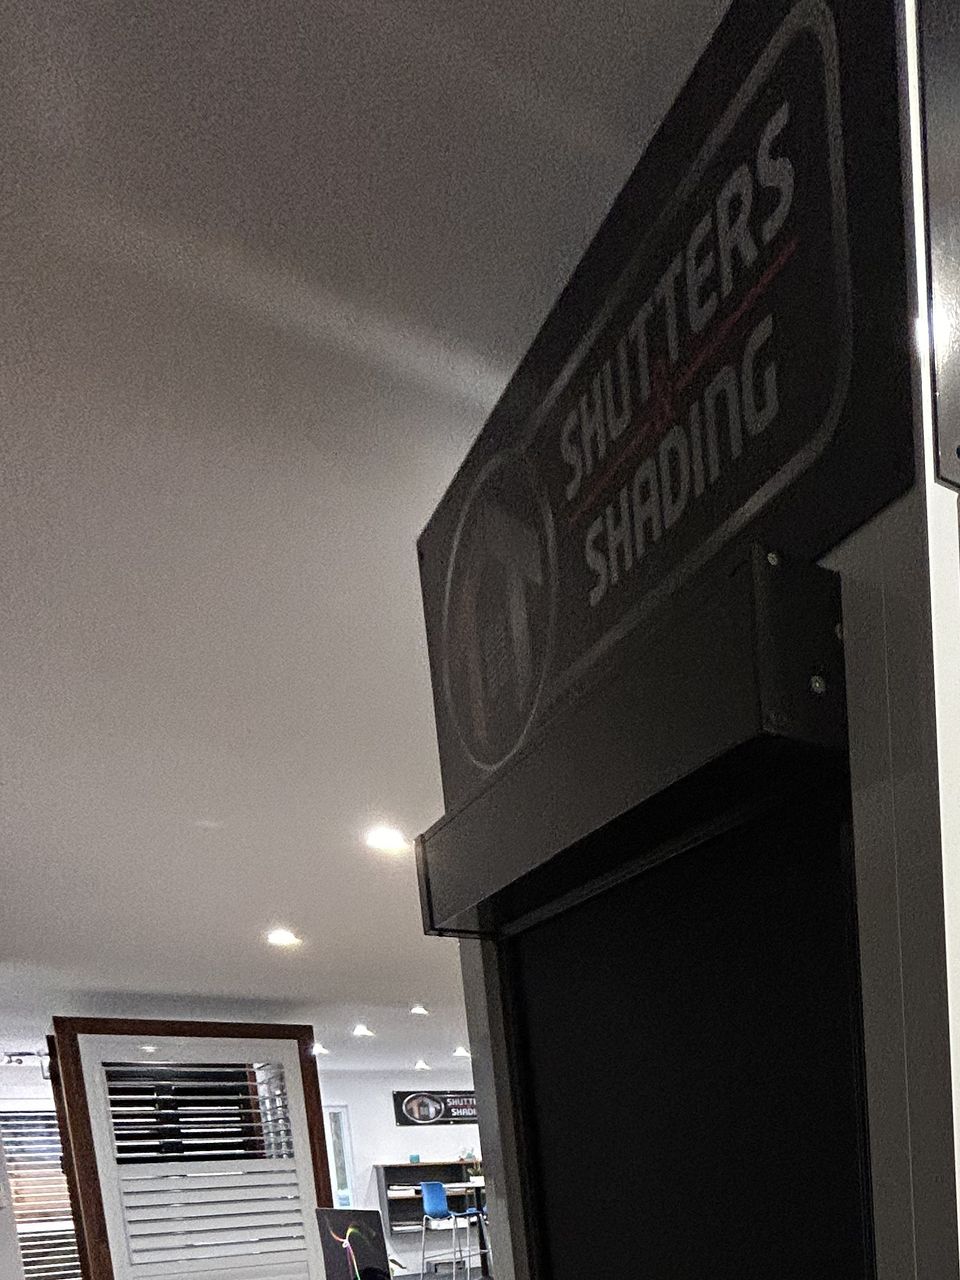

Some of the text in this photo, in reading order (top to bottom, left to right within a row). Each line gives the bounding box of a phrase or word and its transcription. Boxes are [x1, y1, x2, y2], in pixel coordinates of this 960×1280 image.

[561, 102, 796, 501] SHUTTERS
[586, 313, 780, 607] SHADING
[446, 1098, 476, 1106] SHUTT
